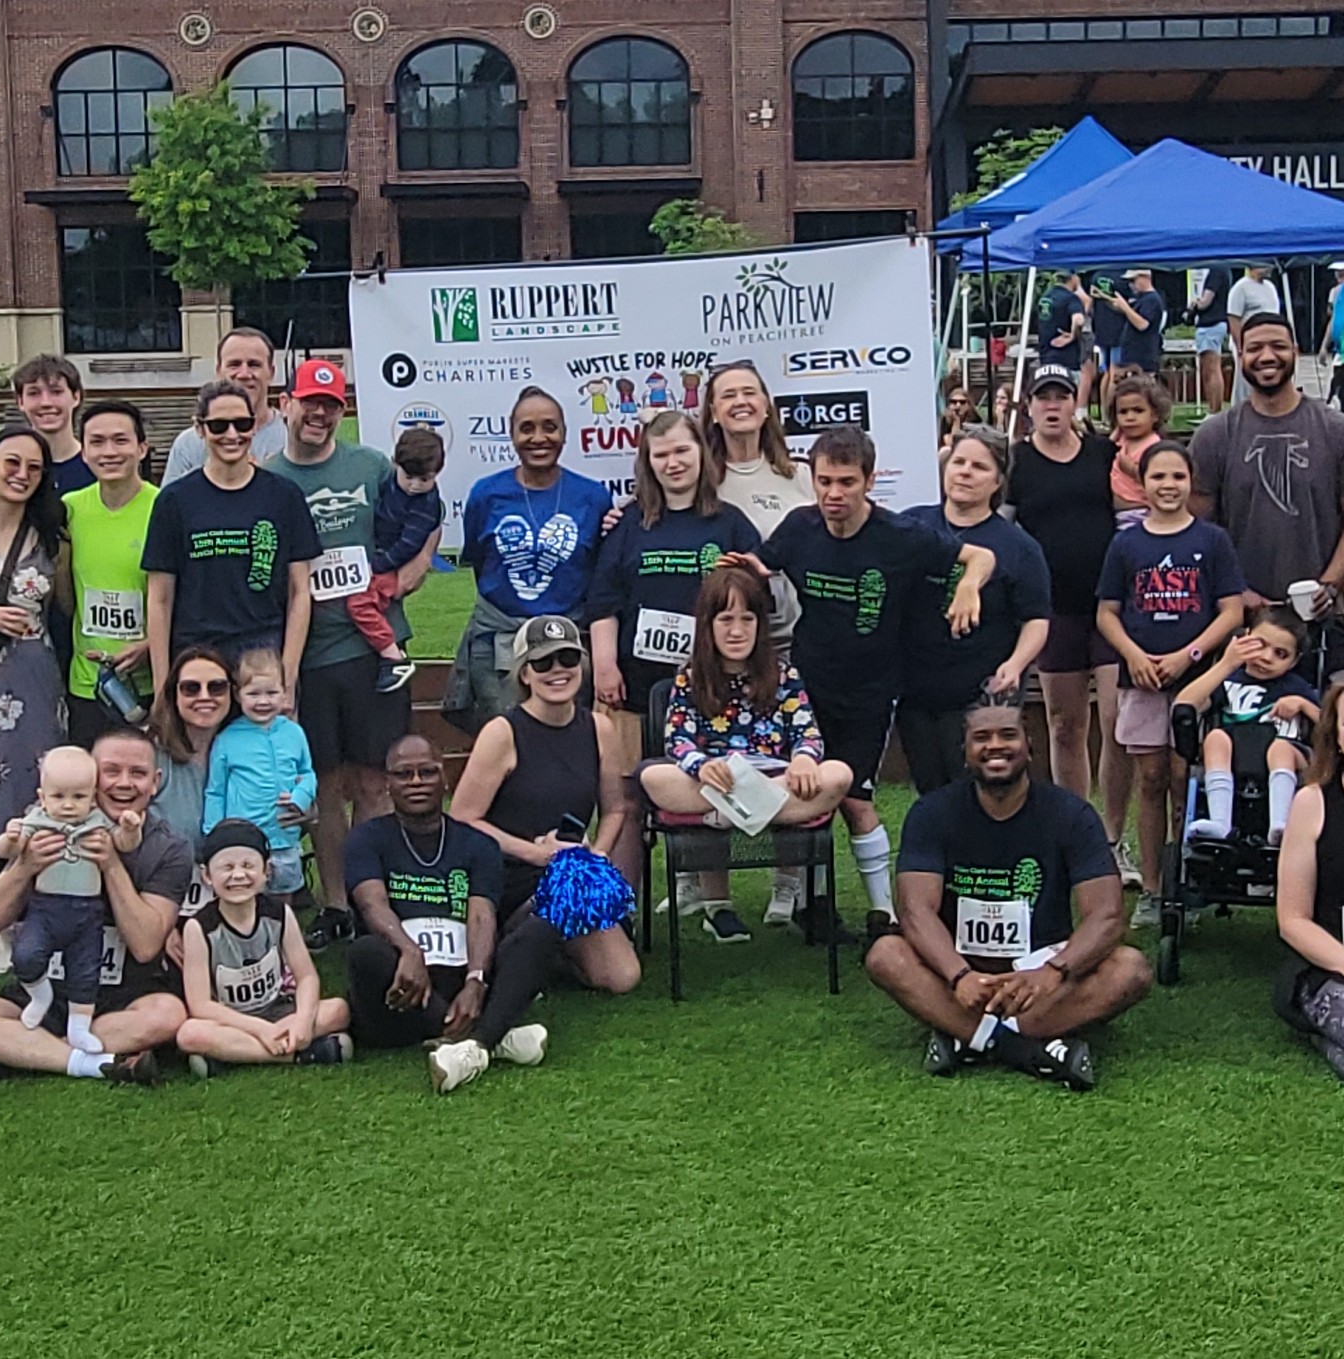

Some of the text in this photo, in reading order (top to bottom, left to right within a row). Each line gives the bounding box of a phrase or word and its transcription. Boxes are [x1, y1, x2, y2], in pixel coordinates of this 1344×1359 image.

[489, 282, 618, 319] RUPPERT
[703, 283, 834, 333] PARKVIEW
[492, 323, 620, 336] LANDSCAPE
[711, 325, 825, 347] ON PEACHTREE
[567, 351, 718, 378] HUSTLE FOR HOPE
[788, 346, 912, 373] SERVCO
[423, 367, 533, 382] CHARITIES
[780, 402, 864, 426] FORGE
[581, 424, 641, 453] FUN
[216, 537, 248, 546] Annual
[665, 556, 696, 564] Annual
[310, 563, 362, 590] 1003
[1135, 567, 1200, 594] EAST
[644, 627, 691, 655] 1062
[410, 883, 446, 893] Annual
[976, 876, 1009, 886] Annual
[423, 894, 448, 904] Hope
[418, 931, 455, 955] 971
[964, 919, 1020, 945] 1042
[224, 968, 275, 1004] 1095
